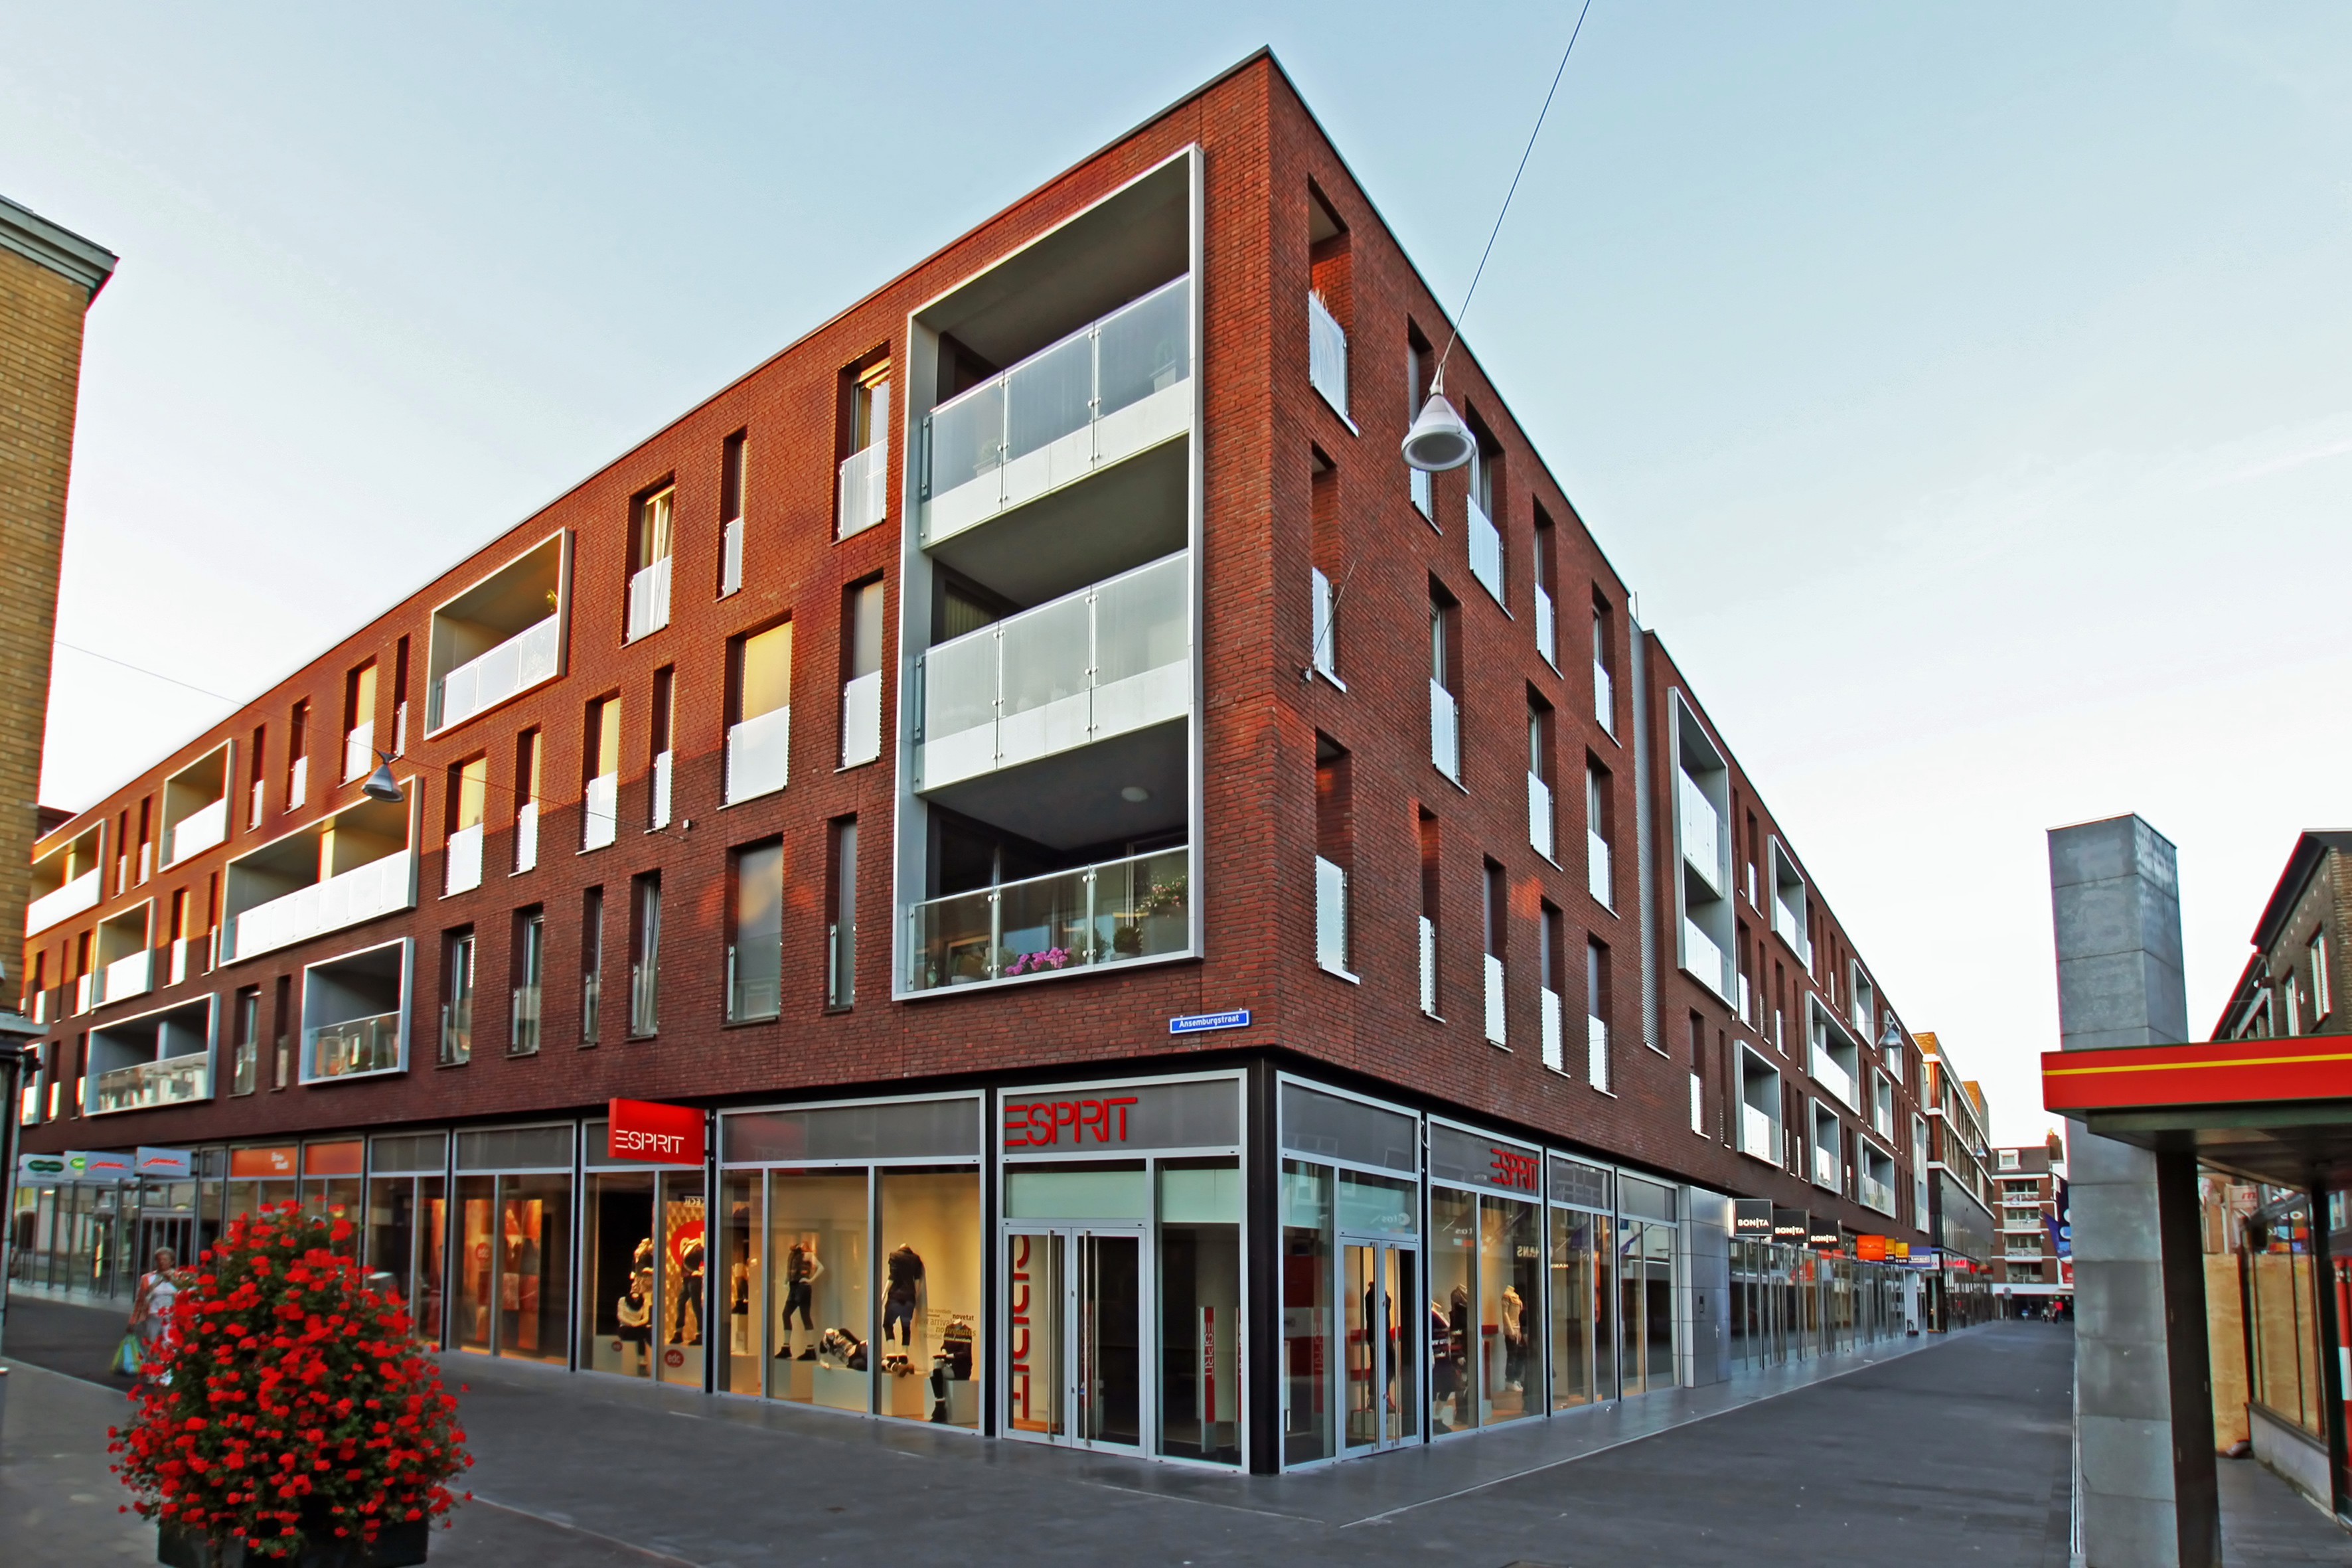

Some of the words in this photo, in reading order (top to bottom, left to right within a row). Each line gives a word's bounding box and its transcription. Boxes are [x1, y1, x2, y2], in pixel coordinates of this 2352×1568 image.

[1178, 1014, 1239, 1028] Ansemburgstraat
[1004, 1097, 1138, 1146] ESPRIT
[615, 1129, 684, 1154] ESPRIT
[1490, 1148, 1540, 1190] ESPRIT
[1737, 1217, 1770, 1228] BONITA
[1774, 1225, 1805, 1235] BONITA
[1810, 1234, 1838, 1243] BONITA
[1204, 1322, 1214, 1380] ESPRIT
[667, 1354, 680, 1364] edc
